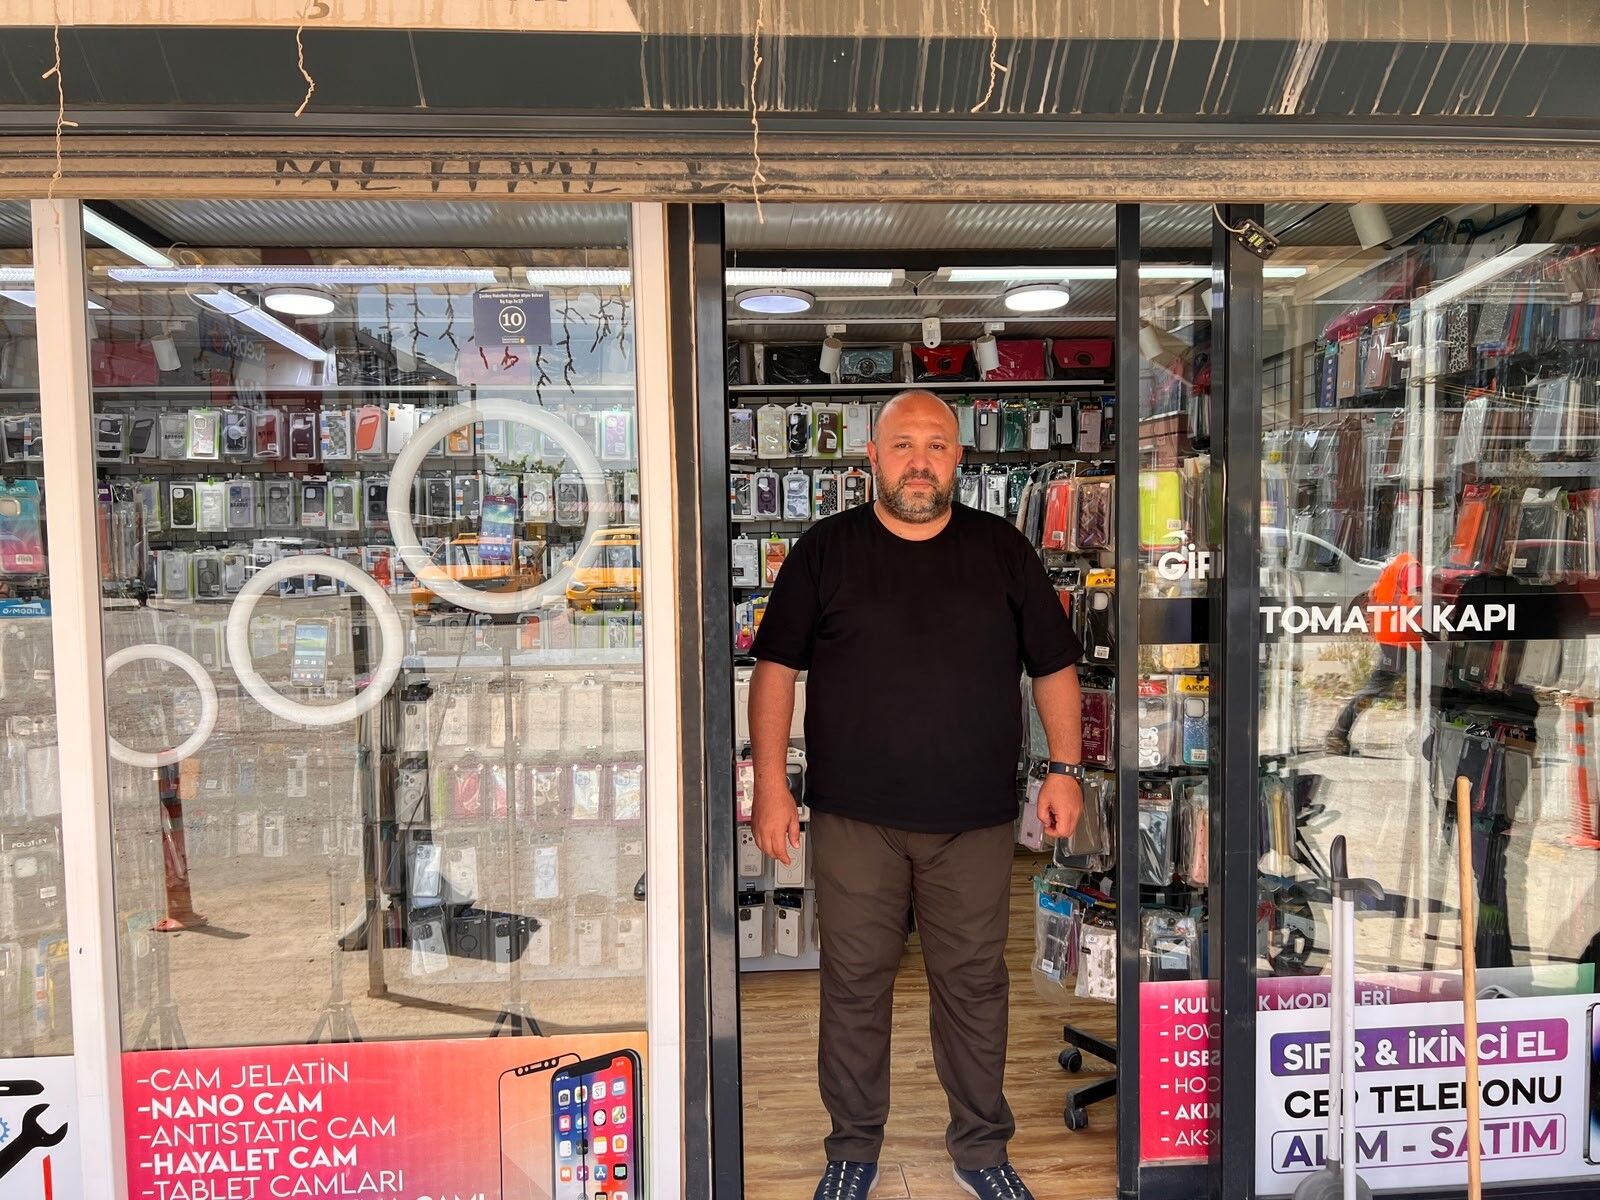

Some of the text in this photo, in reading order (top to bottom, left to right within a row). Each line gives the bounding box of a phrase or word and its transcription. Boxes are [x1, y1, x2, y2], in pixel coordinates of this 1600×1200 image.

[502, 312, 523, 326] 10
[1433, 603, 1515, 632] KAPI
[1277, 989, 1391, 1010] MODERİ
[1283, 1025, 1556, 1071] SIFR & İKİNCİ EL
[231, 1058, 349, 1088] JELATİN
[253, 1091, 323, 1115] CAM
[1284, 1089, 1359, 1119] CE
[326, 1115, 397, 1140] CAM
[1430, 1119, 1558, 1159] SATIM
[289, 1144, 358, 1169] CAM
[269, 1169, 404, 1198] CAMLARI
